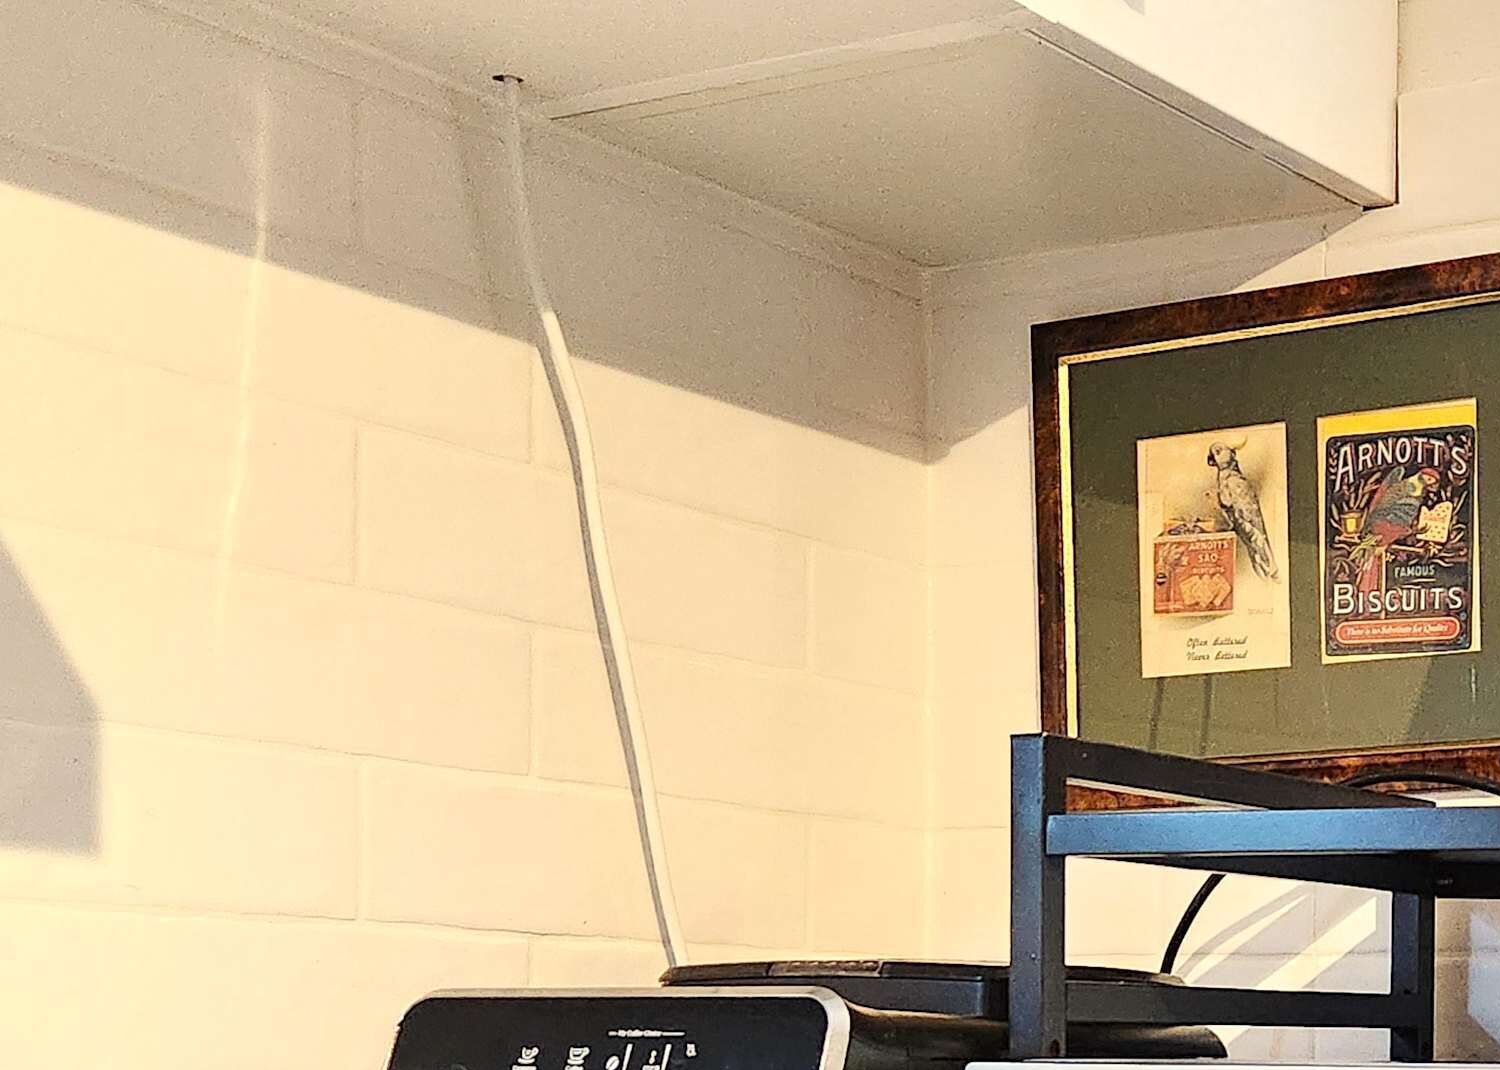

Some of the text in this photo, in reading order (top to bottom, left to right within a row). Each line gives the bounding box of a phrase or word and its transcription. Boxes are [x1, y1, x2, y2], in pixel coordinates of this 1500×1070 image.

[1333, 434, 1468, 494] ARNOTT'S
[1395, 564, 1436, 578] FAMOUS
[1332, 583, 1464, 616] BISCUITS
